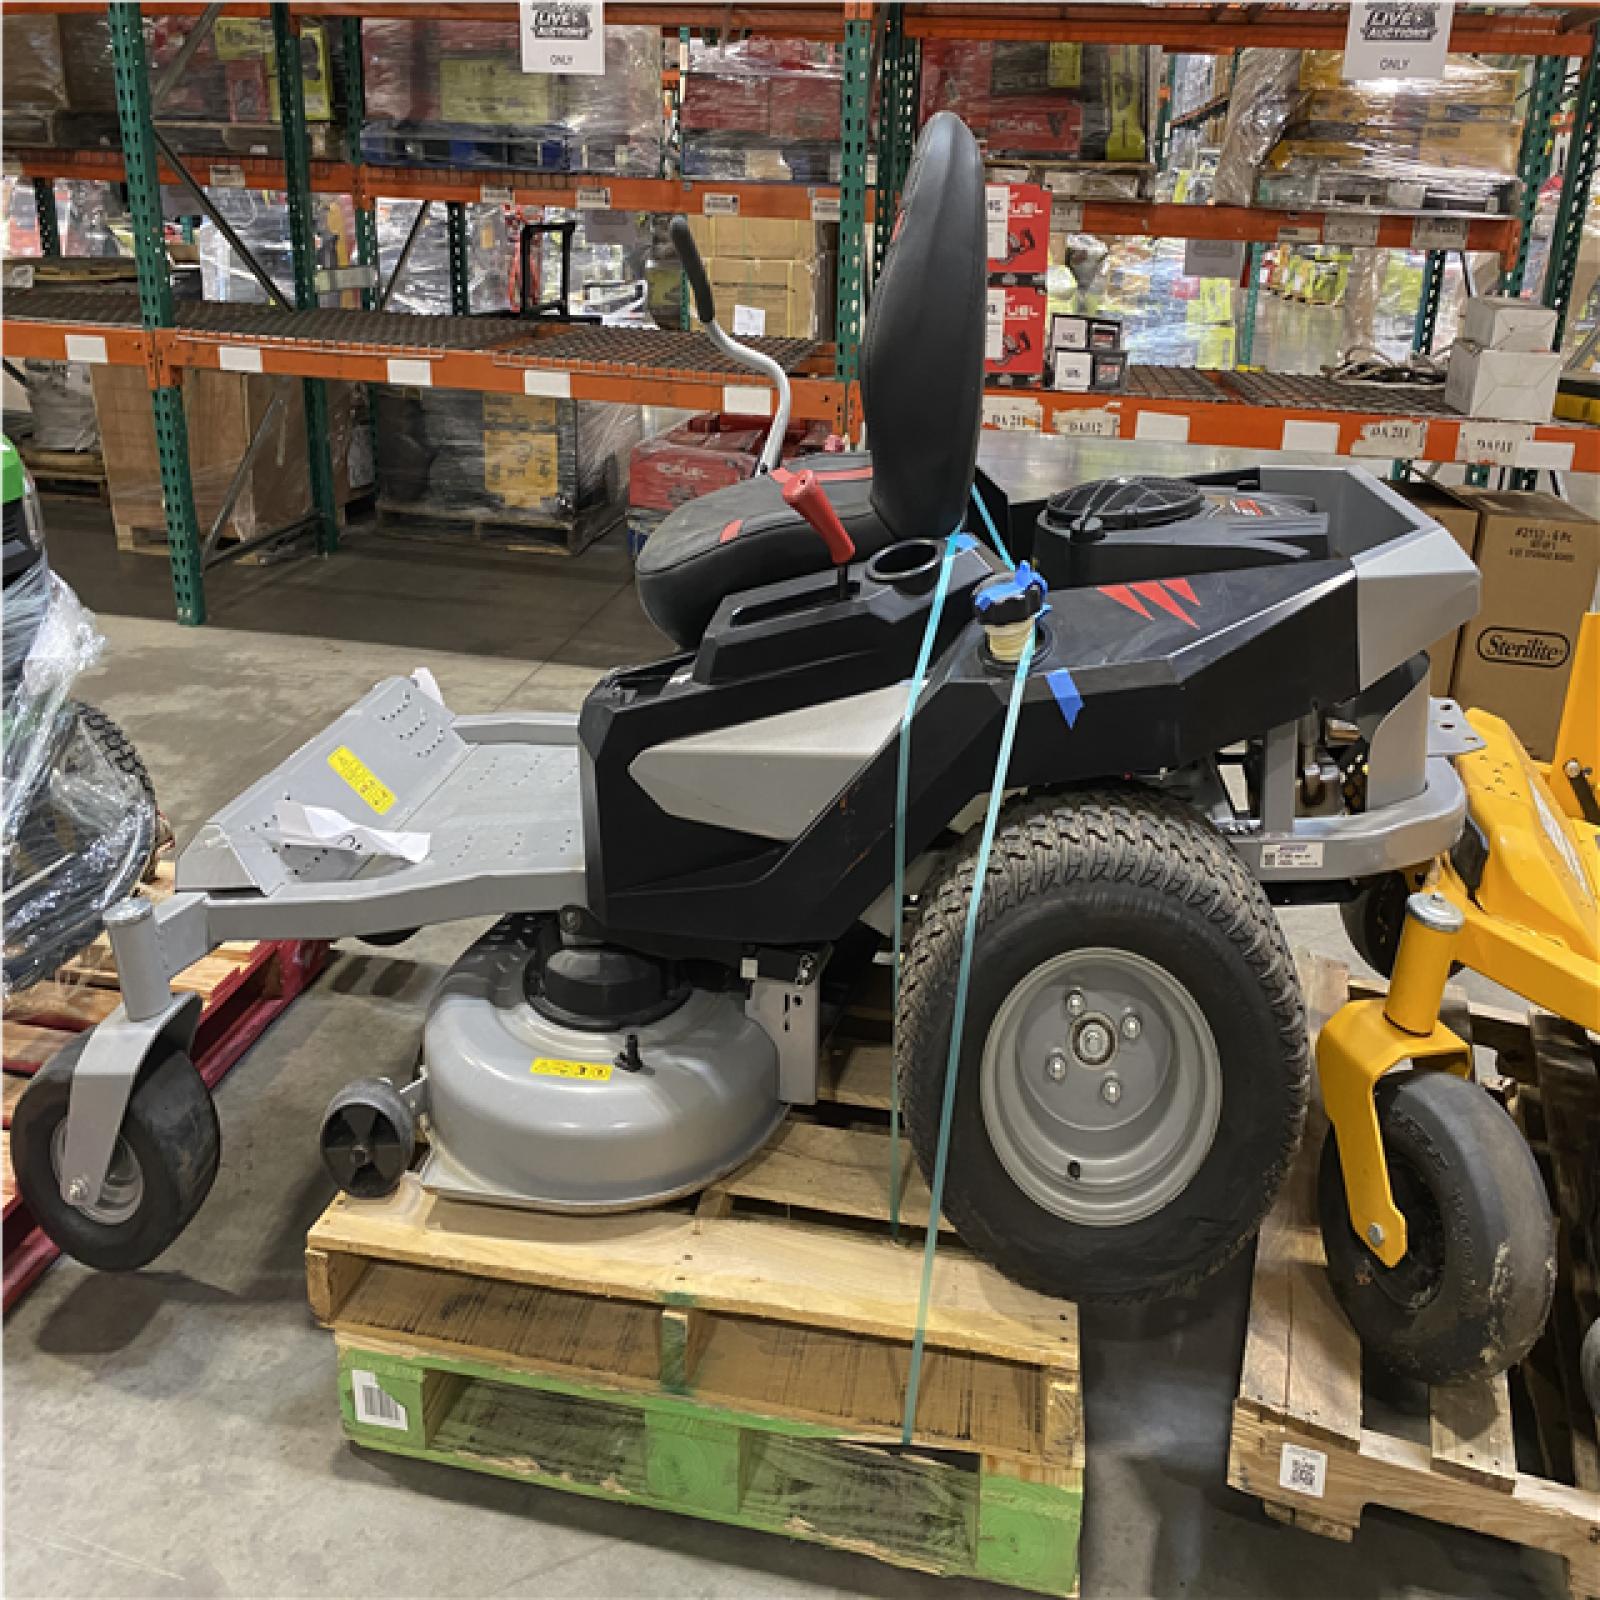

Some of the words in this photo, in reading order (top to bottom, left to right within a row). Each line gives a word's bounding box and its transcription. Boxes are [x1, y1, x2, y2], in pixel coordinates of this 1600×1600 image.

[537, 12, 571, 27] LIVE
[1369, 12, 1413, 27] LIVE
[549, 54, 574, 66] ONLY
[1379, 57, 1410, 71] ONLY
[1485, 633, 1562, 662] Sterilite
